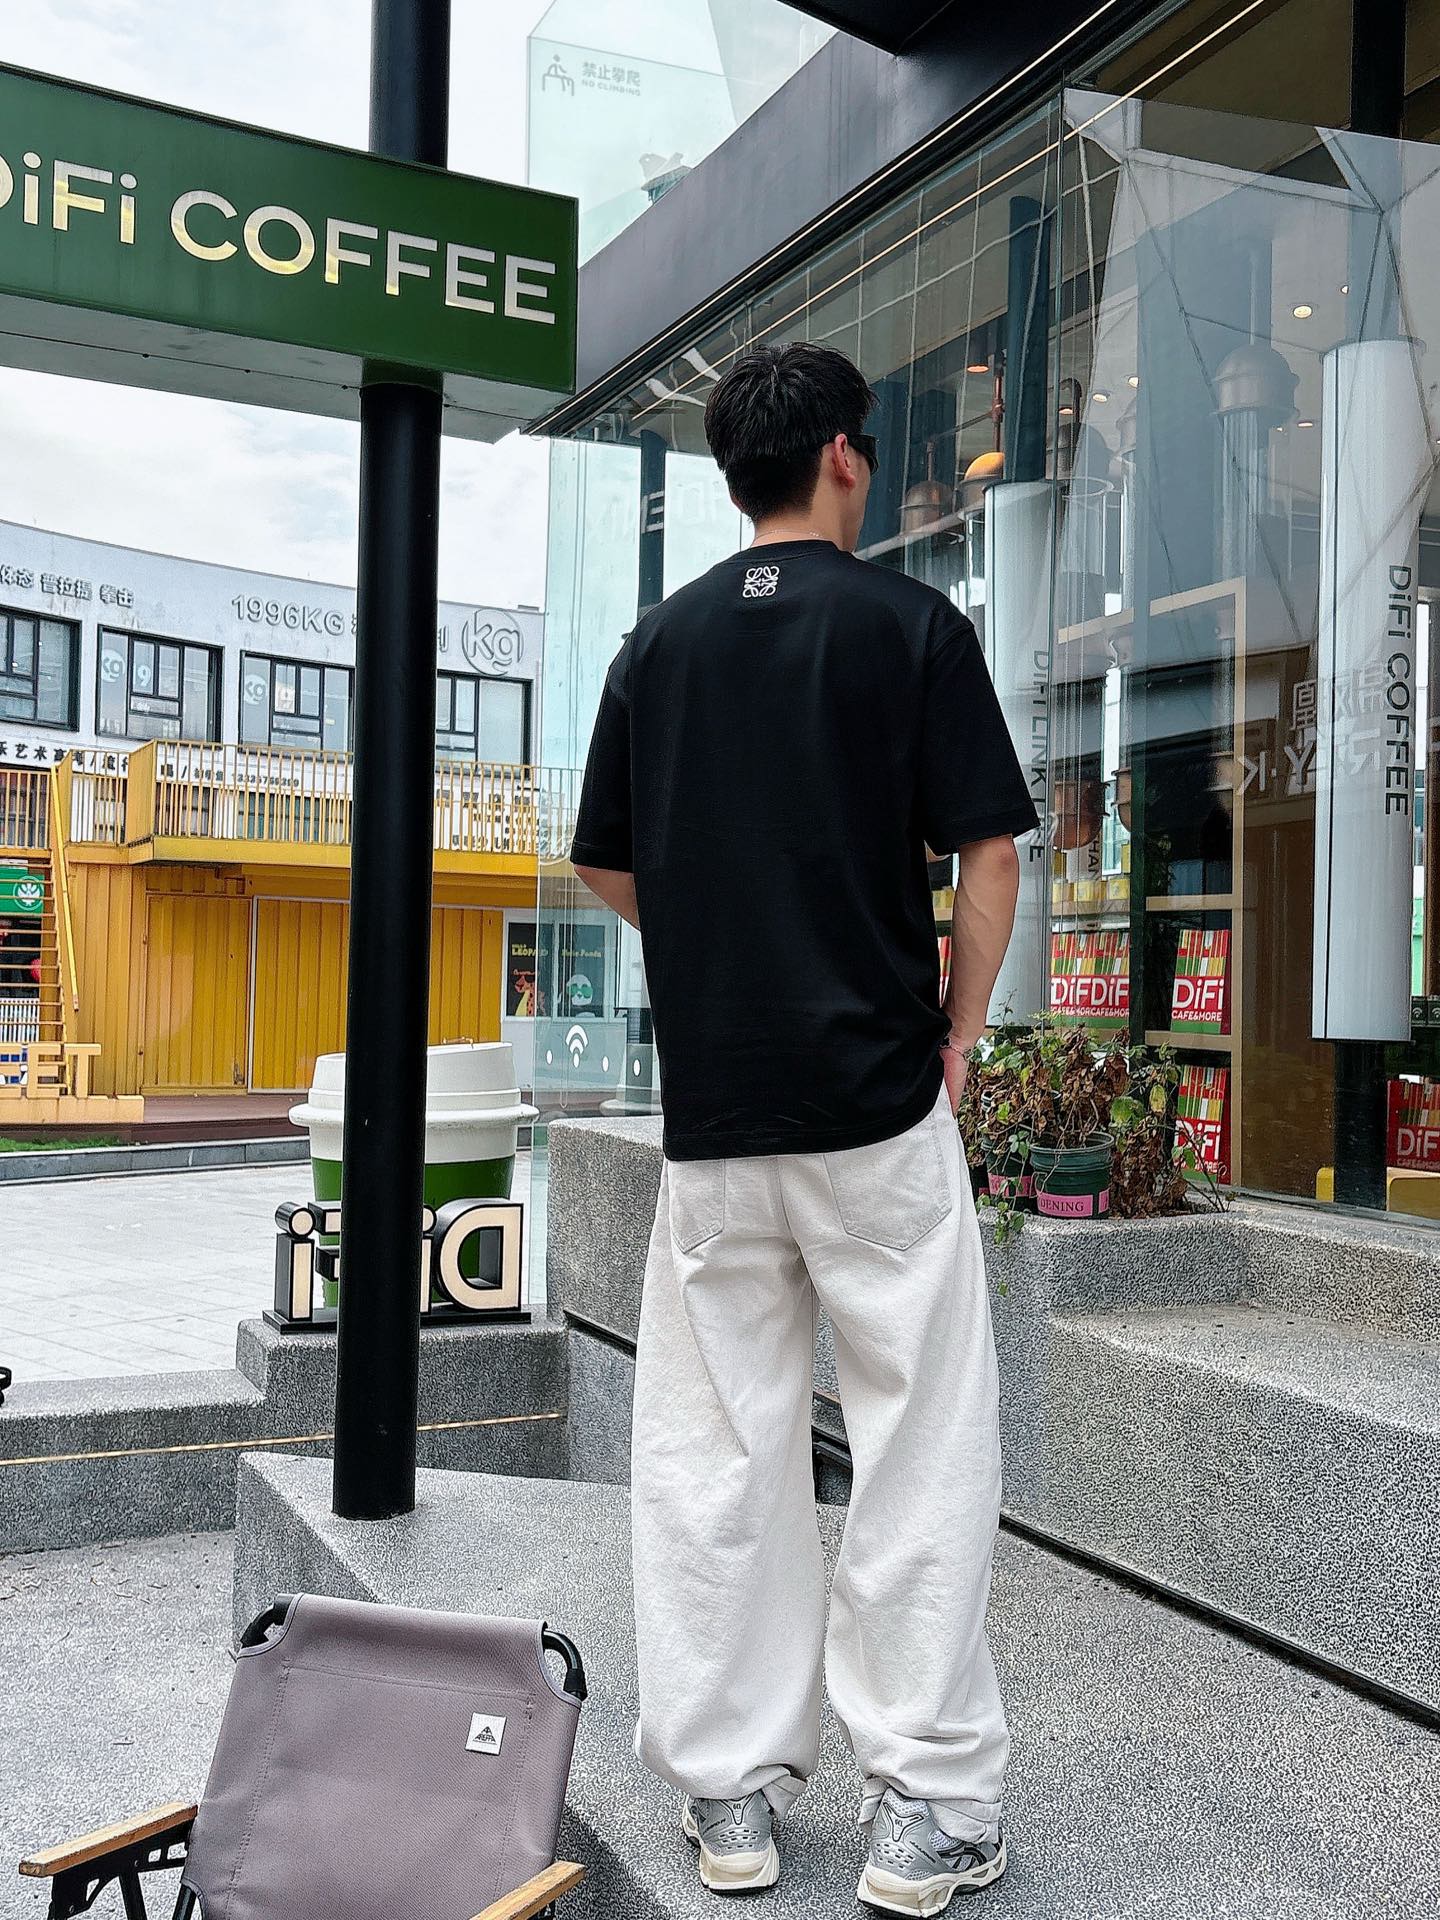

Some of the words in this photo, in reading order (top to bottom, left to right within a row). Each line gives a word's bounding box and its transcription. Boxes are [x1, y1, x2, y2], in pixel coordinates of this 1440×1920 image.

[581, 61, 641, 88] 禁止攀爬
[581, 80, 595, 88] NO
[597, 81, 641, 97] CLIMBING
[170, 189, 556, 325] COFFEE
[40, 572, 93, 602] 普拉提
[99, 583, 135, 609] 拳击
[1387, 564, 1413, 638] DiFi
[231, 594, 346, 637] 1996KG
[1384, 653, 1411, 817] COFFEE
[1172, 979, 1224, 1010] DiFi
[1171, 1009, 1222, 1022] CAFE&MORE
